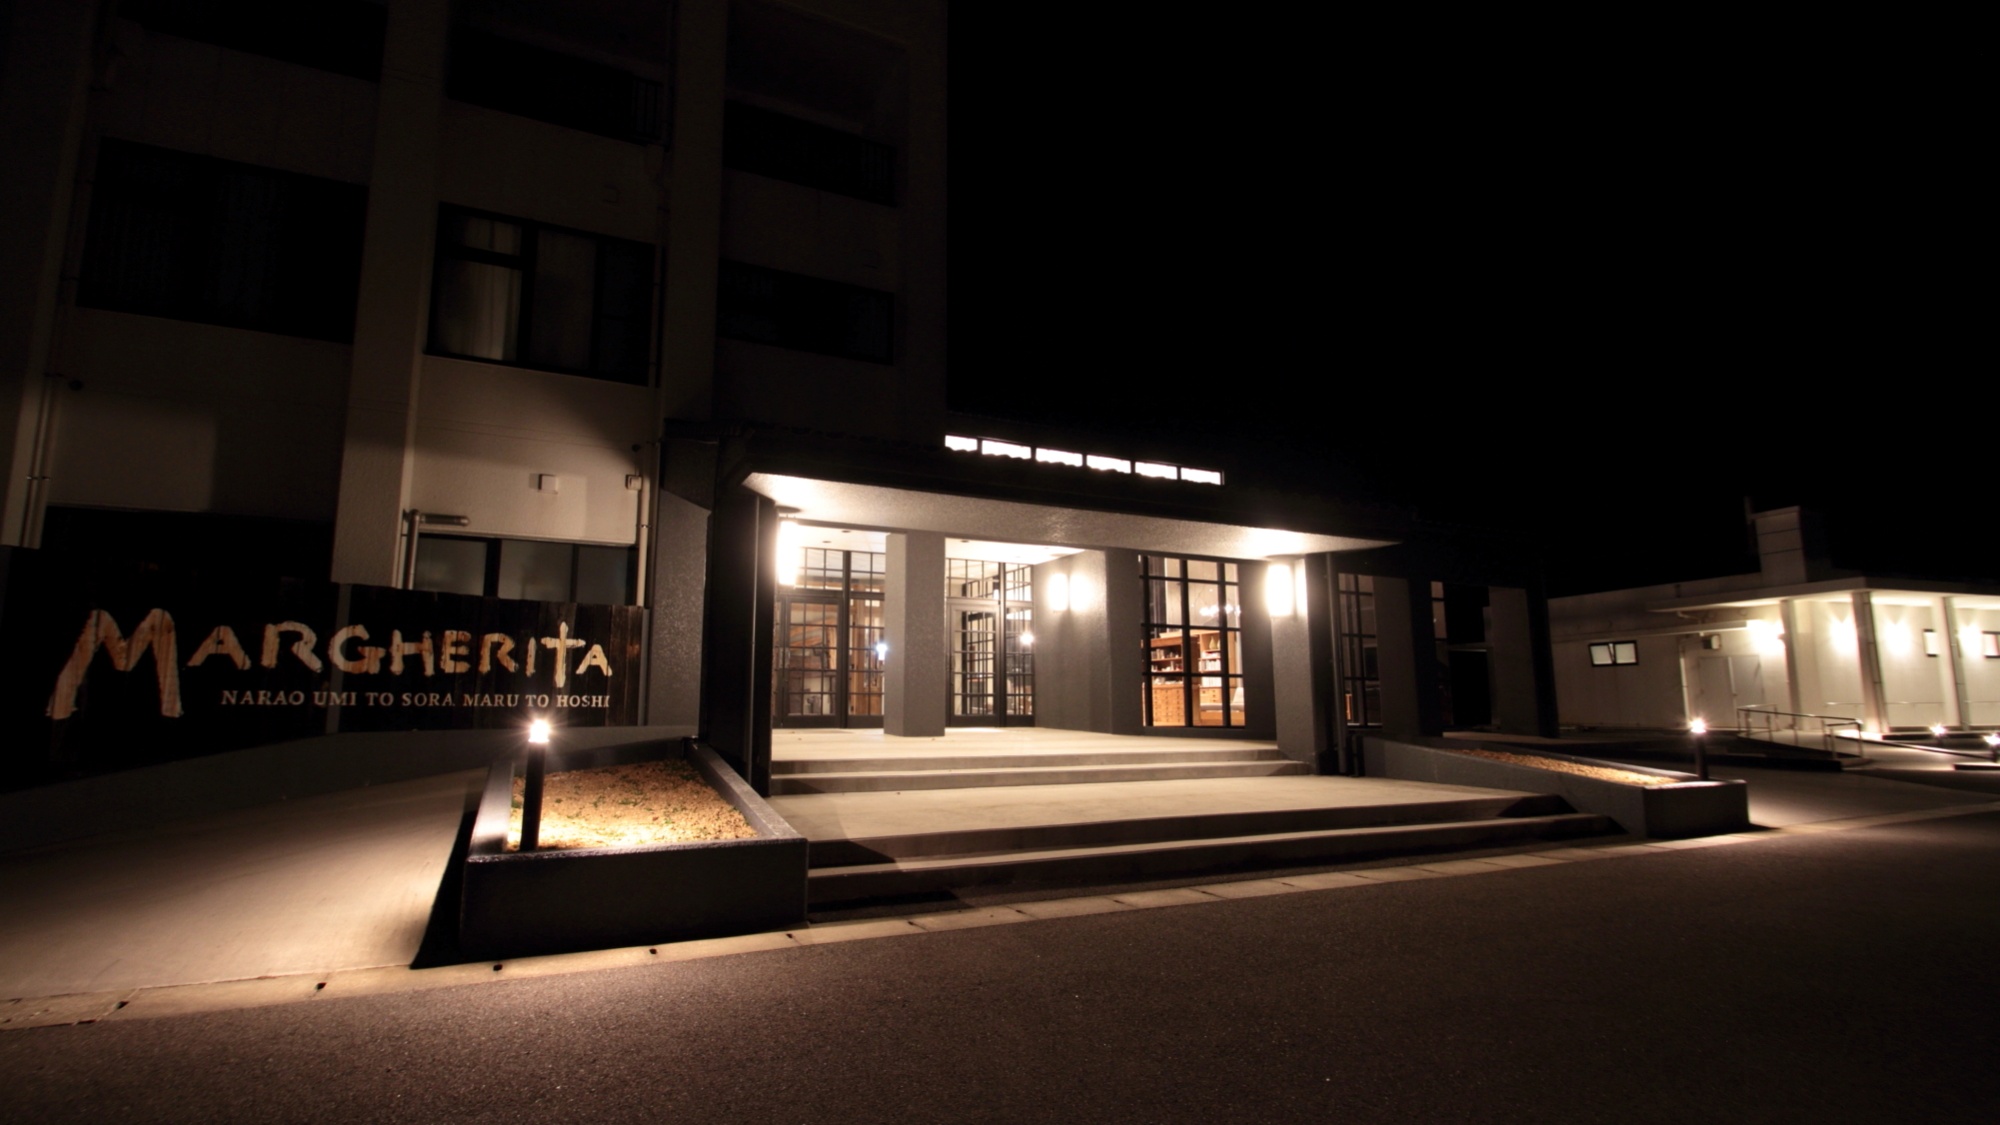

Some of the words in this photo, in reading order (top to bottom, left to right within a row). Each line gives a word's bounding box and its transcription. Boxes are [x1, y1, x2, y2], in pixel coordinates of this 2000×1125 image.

[46, 608, 613, 720] MARGHERITA
[221, 690, 305, 706] NARAO
[313, 691, 357, 706] UMI
[365, 692, 394, 706] TO
[402, 692, 455, 707] SORA
[463, 693, 519, 707] MARU
[526, 694, 549, 708] TO
[556, 694, 610, 708] HOSHI
